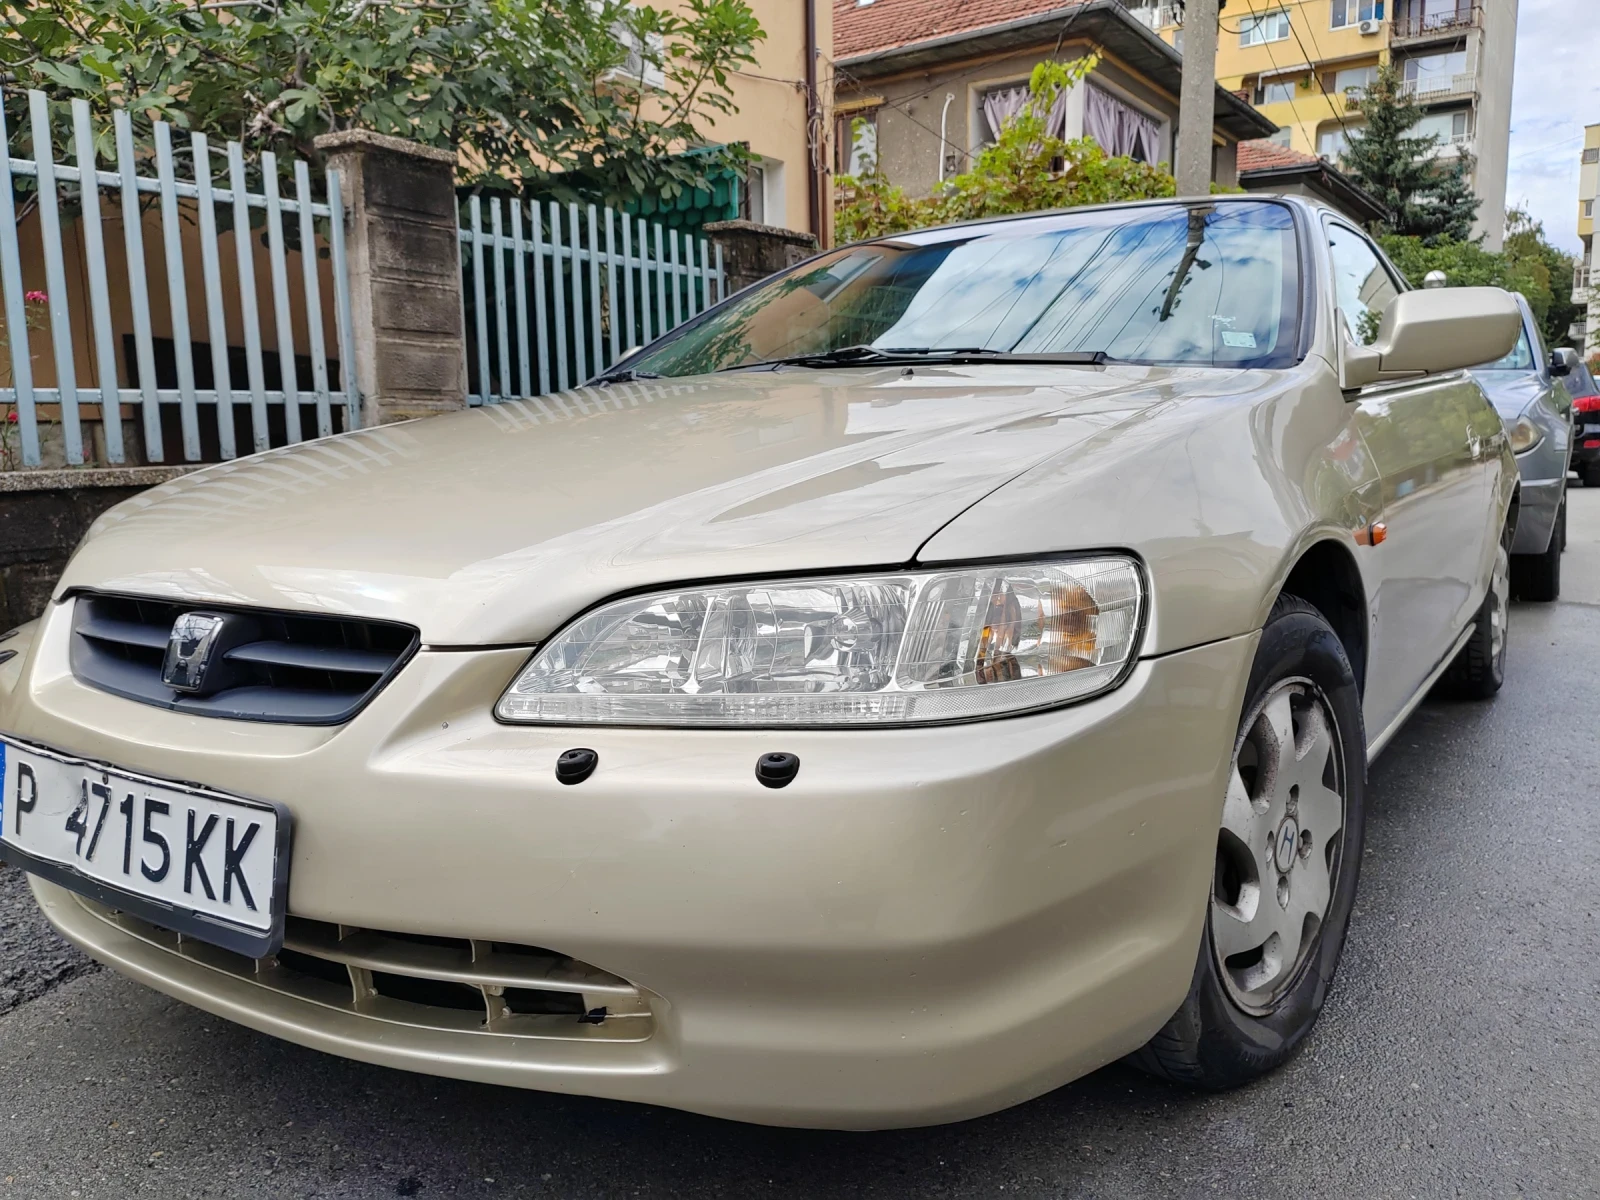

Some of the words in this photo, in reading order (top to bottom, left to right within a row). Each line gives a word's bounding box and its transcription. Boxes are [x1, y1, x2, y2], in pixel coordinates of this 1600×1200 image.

[15, 761, 38, 835] P
[65, 778, 170, 882] 4715
[184, 808, 261, 911] KK
